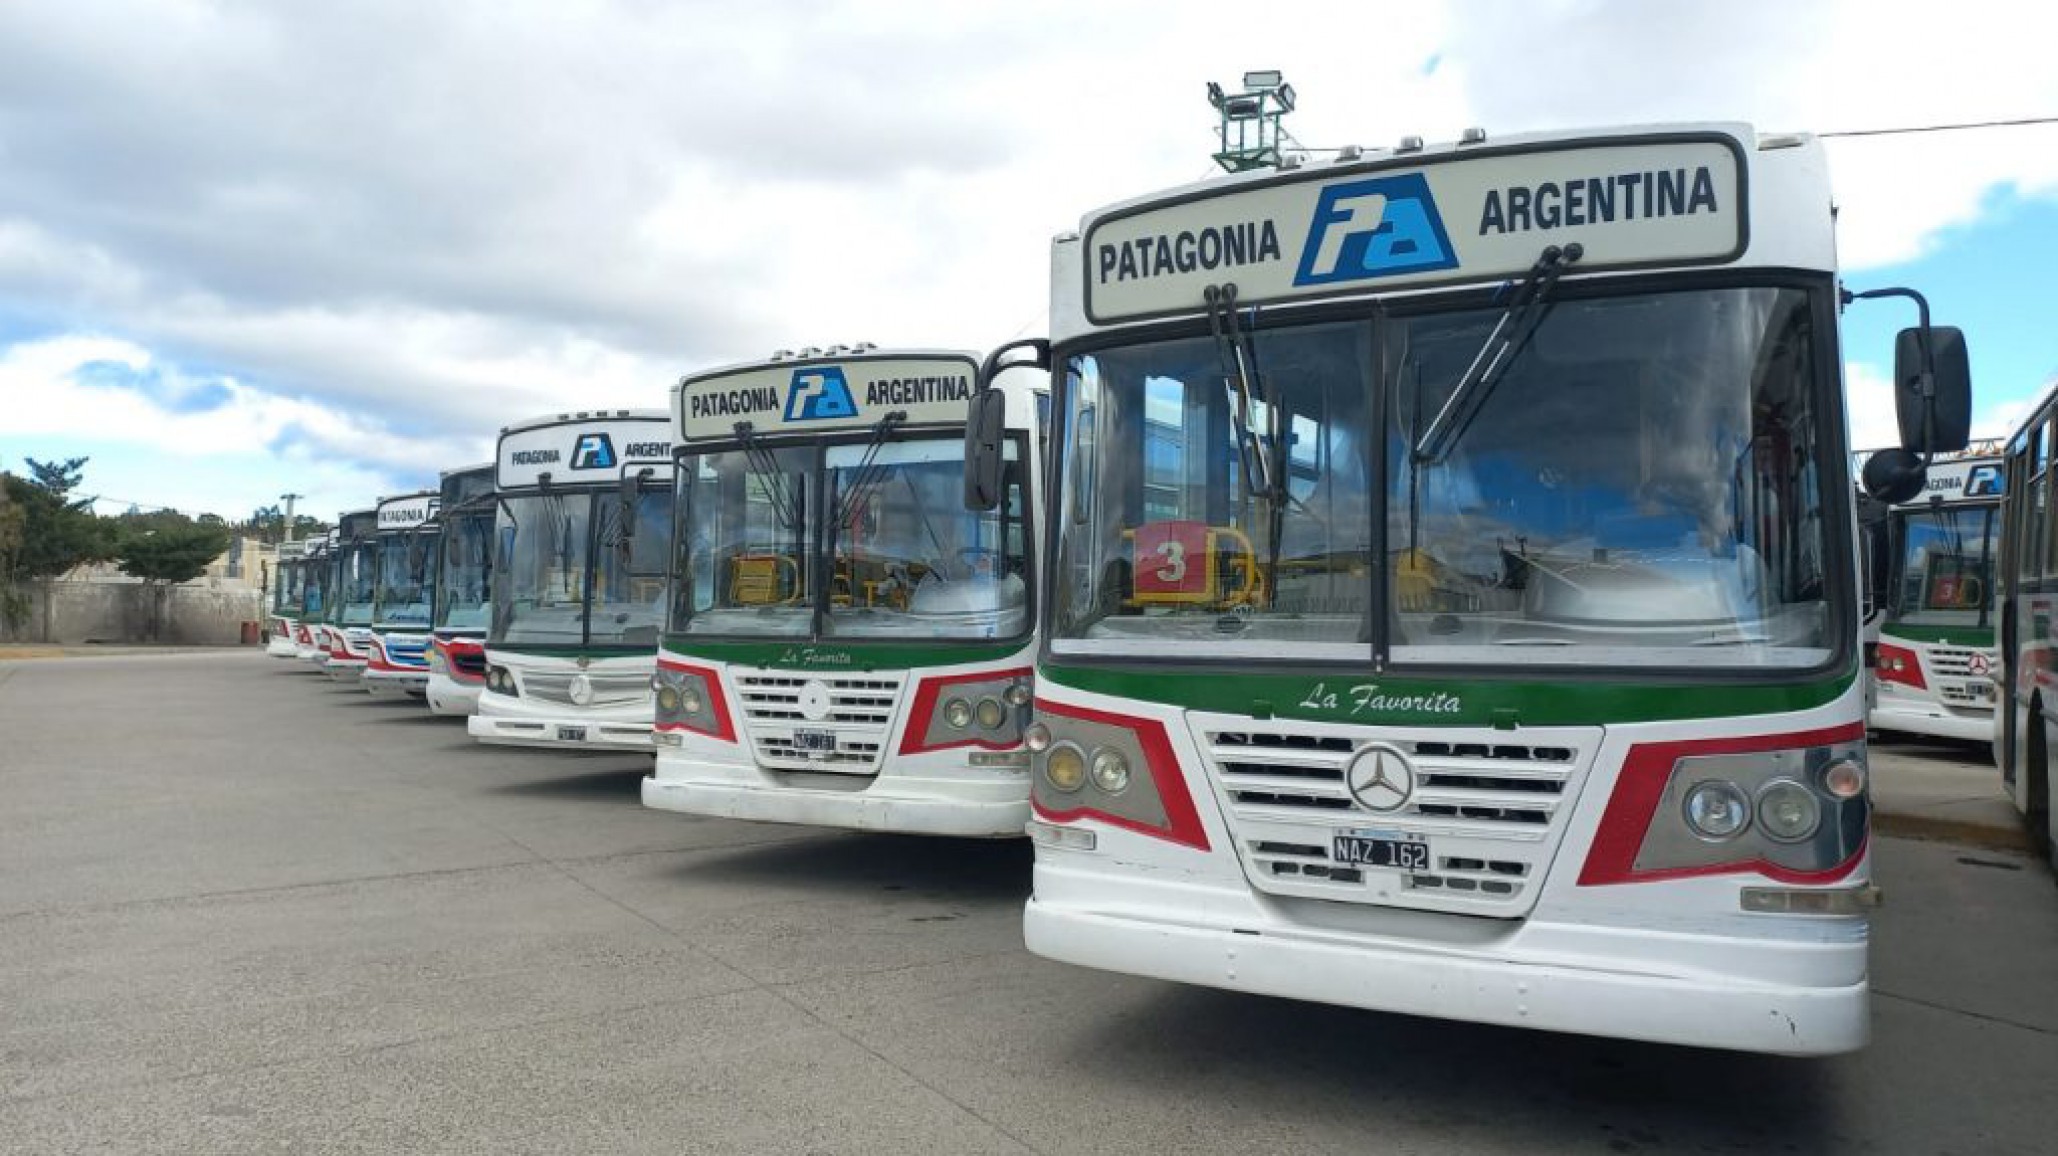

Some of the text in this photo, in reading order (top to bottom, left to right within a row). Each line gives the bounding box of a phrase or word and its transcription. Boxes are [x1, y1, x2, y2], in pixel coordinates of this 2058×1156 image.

[1099, 220, 1281, 284] PATAGONIA
[1478, 166, 1718, 236] ARGENTINA
[690, 386, 780, 419] PATAGONIA
[866, 375, 971, 406] ARGENTINA
[511, 449, 561, 467] PATAGONIA
[624, 441, 672, 457] ARGENT
[1924, 476, 1962, 491] AGONIA
[1156, 541, 1187, 582] 3
[1299, 682, 1462, 715] La Favorita
[1335, 837, 1427, 868] NAZ 162
